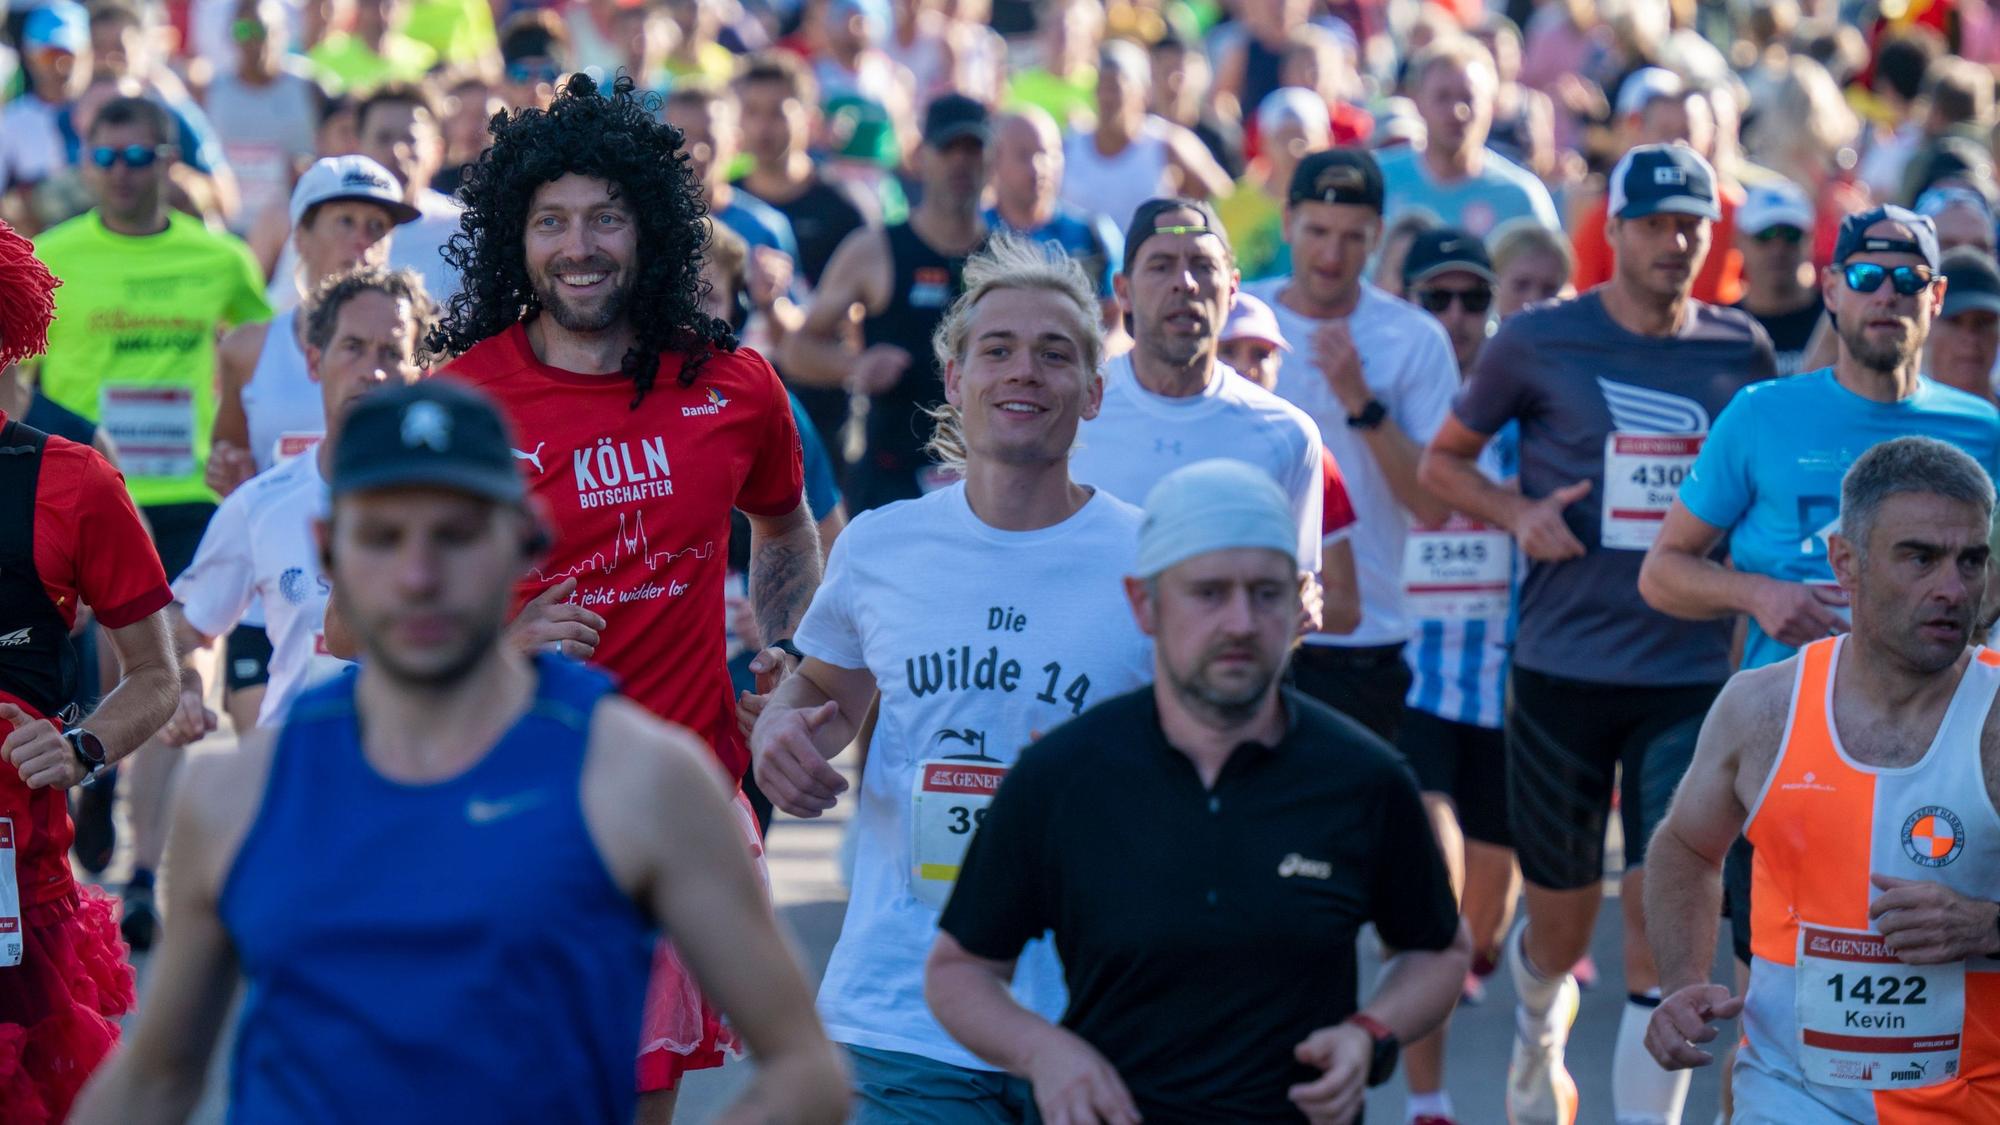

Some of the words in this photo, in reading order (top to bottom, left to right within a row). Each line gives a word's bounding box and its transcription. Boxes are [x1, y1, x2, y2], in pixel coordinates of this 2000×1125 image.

[681, 403, 719, 417] Daniel
[573, 435, 671, 491] KÖLN
[1630, 464, 1692, 488] 430
[579, 479, 673, 509] BOTSCHAFTER
[619, 581, 665, 603] widder
[668, 579, 690, 597] los
[987, 606, 1027, 633] Die
[905, 645, 1021, 698] Wilde
[1036, 661, 1090, 716] 14
[1827, 973, 1927, 1005] 1422
[1845, 1009, 1905, 1029] Kevin
[1890, 1069, 1921, 1082] PUMA
